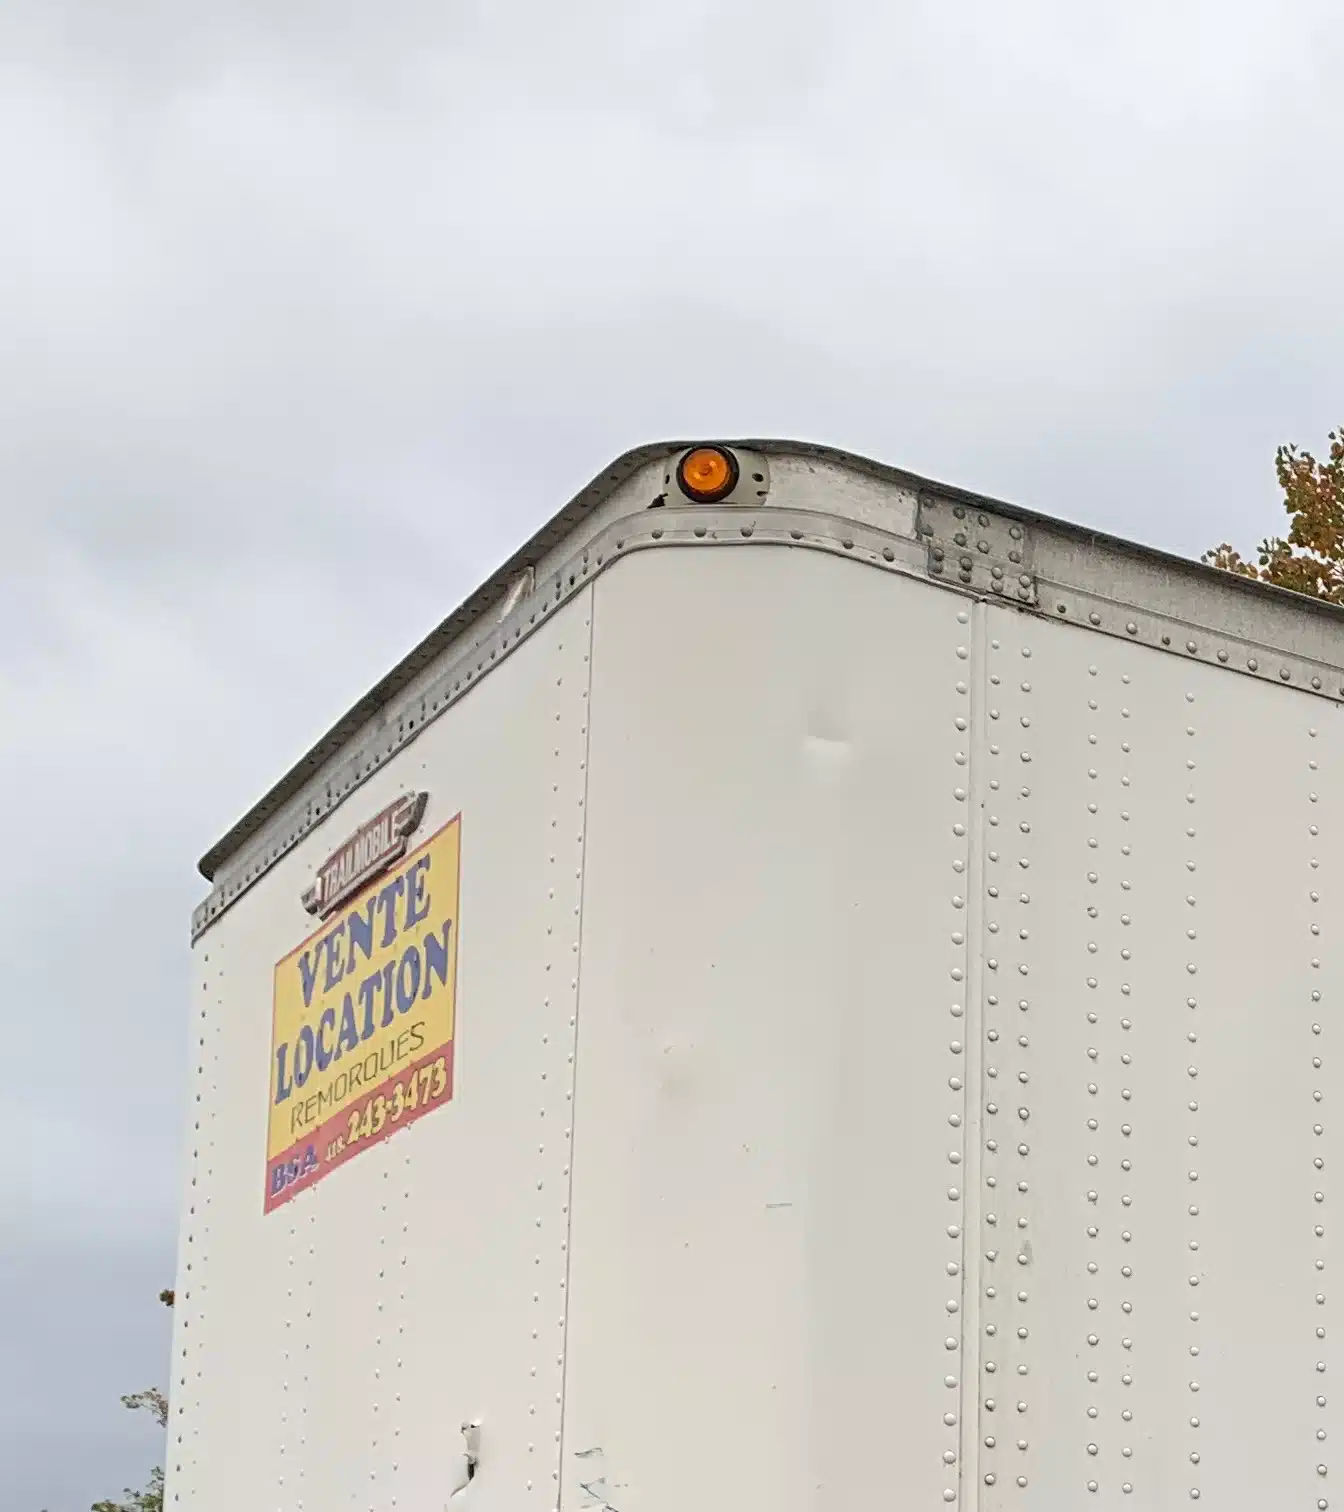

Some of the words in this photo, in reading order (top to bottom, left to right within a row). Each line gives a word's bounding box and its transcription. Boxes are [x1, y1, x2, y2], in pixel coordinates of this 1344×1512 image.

[322, 806, 402, 904] TRAILMOBILE
[297, 853, 431, 1008] VENTE
[273, 919, 452, 1104] LOCATION
[290, 1021, 425, 1134] REMORQUES
[271, 1144, 320, 1198] BSA
[346, 1056, 447, 1144] 243-3473
